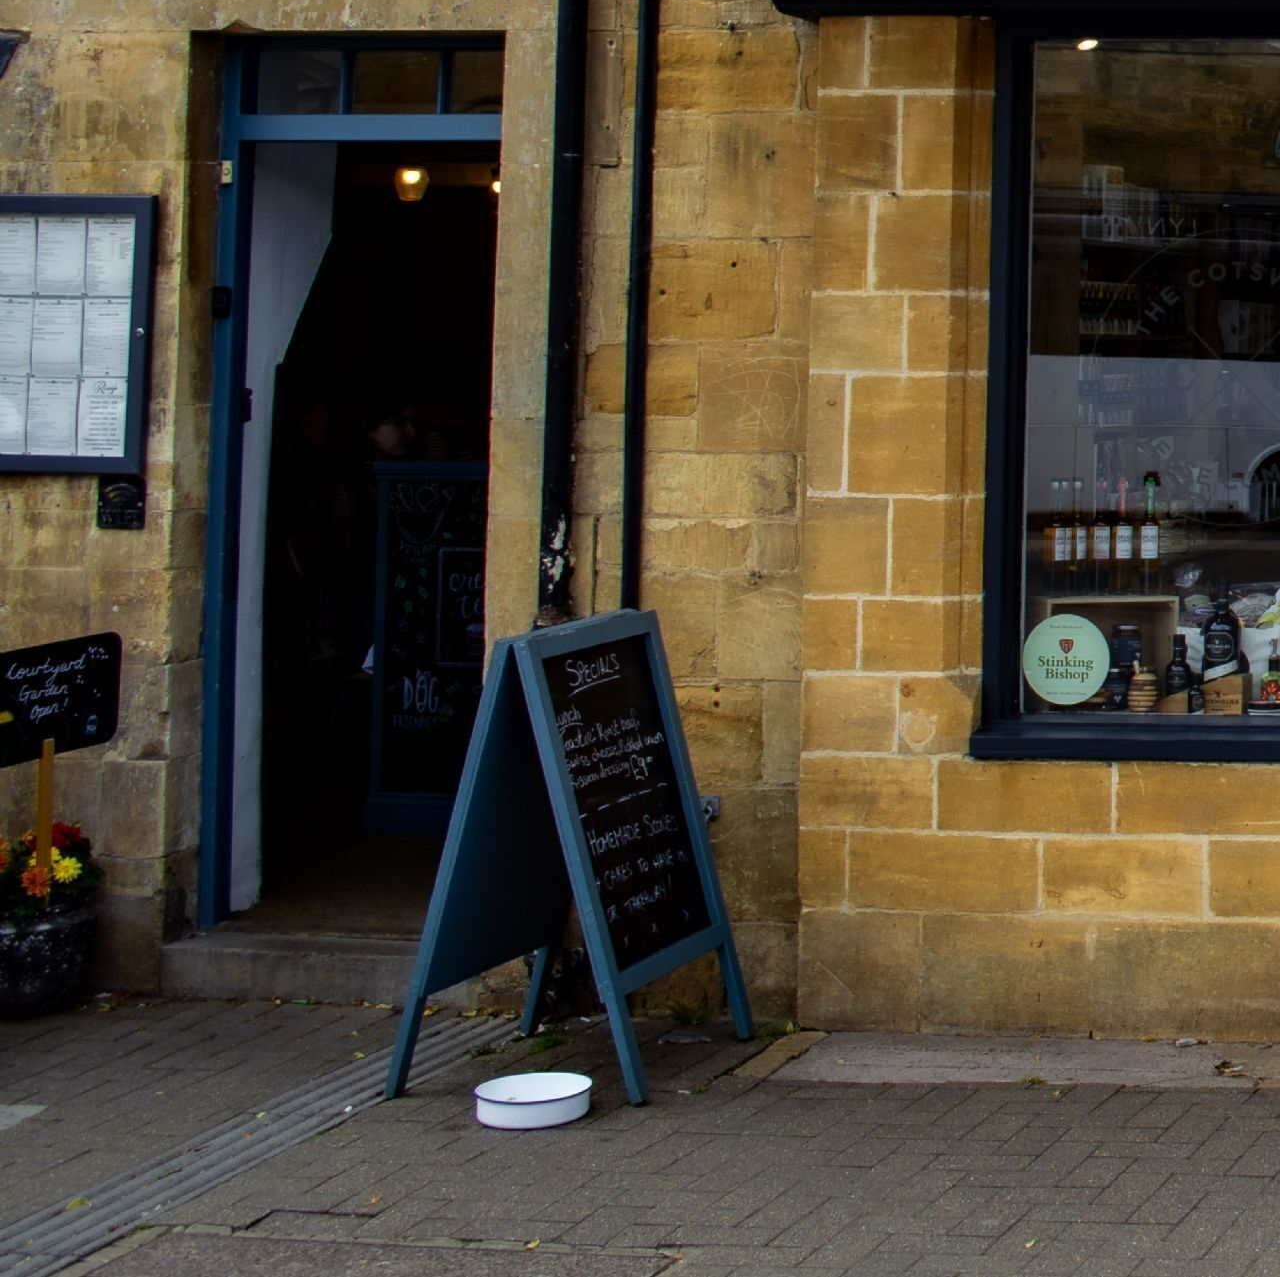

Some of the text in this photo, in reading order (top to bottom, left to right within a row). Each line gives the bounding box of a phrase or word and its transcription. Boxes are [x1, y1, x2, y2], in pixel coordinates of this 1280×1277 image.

[6, 653, 87, 687] Courtyard
[1037, 655, 1095, 672] Stinking
[1045, 668, 1090, 684] Bishop
[19, 684, 69, 703] Garden
[402, 675, 441, 713] DOG
